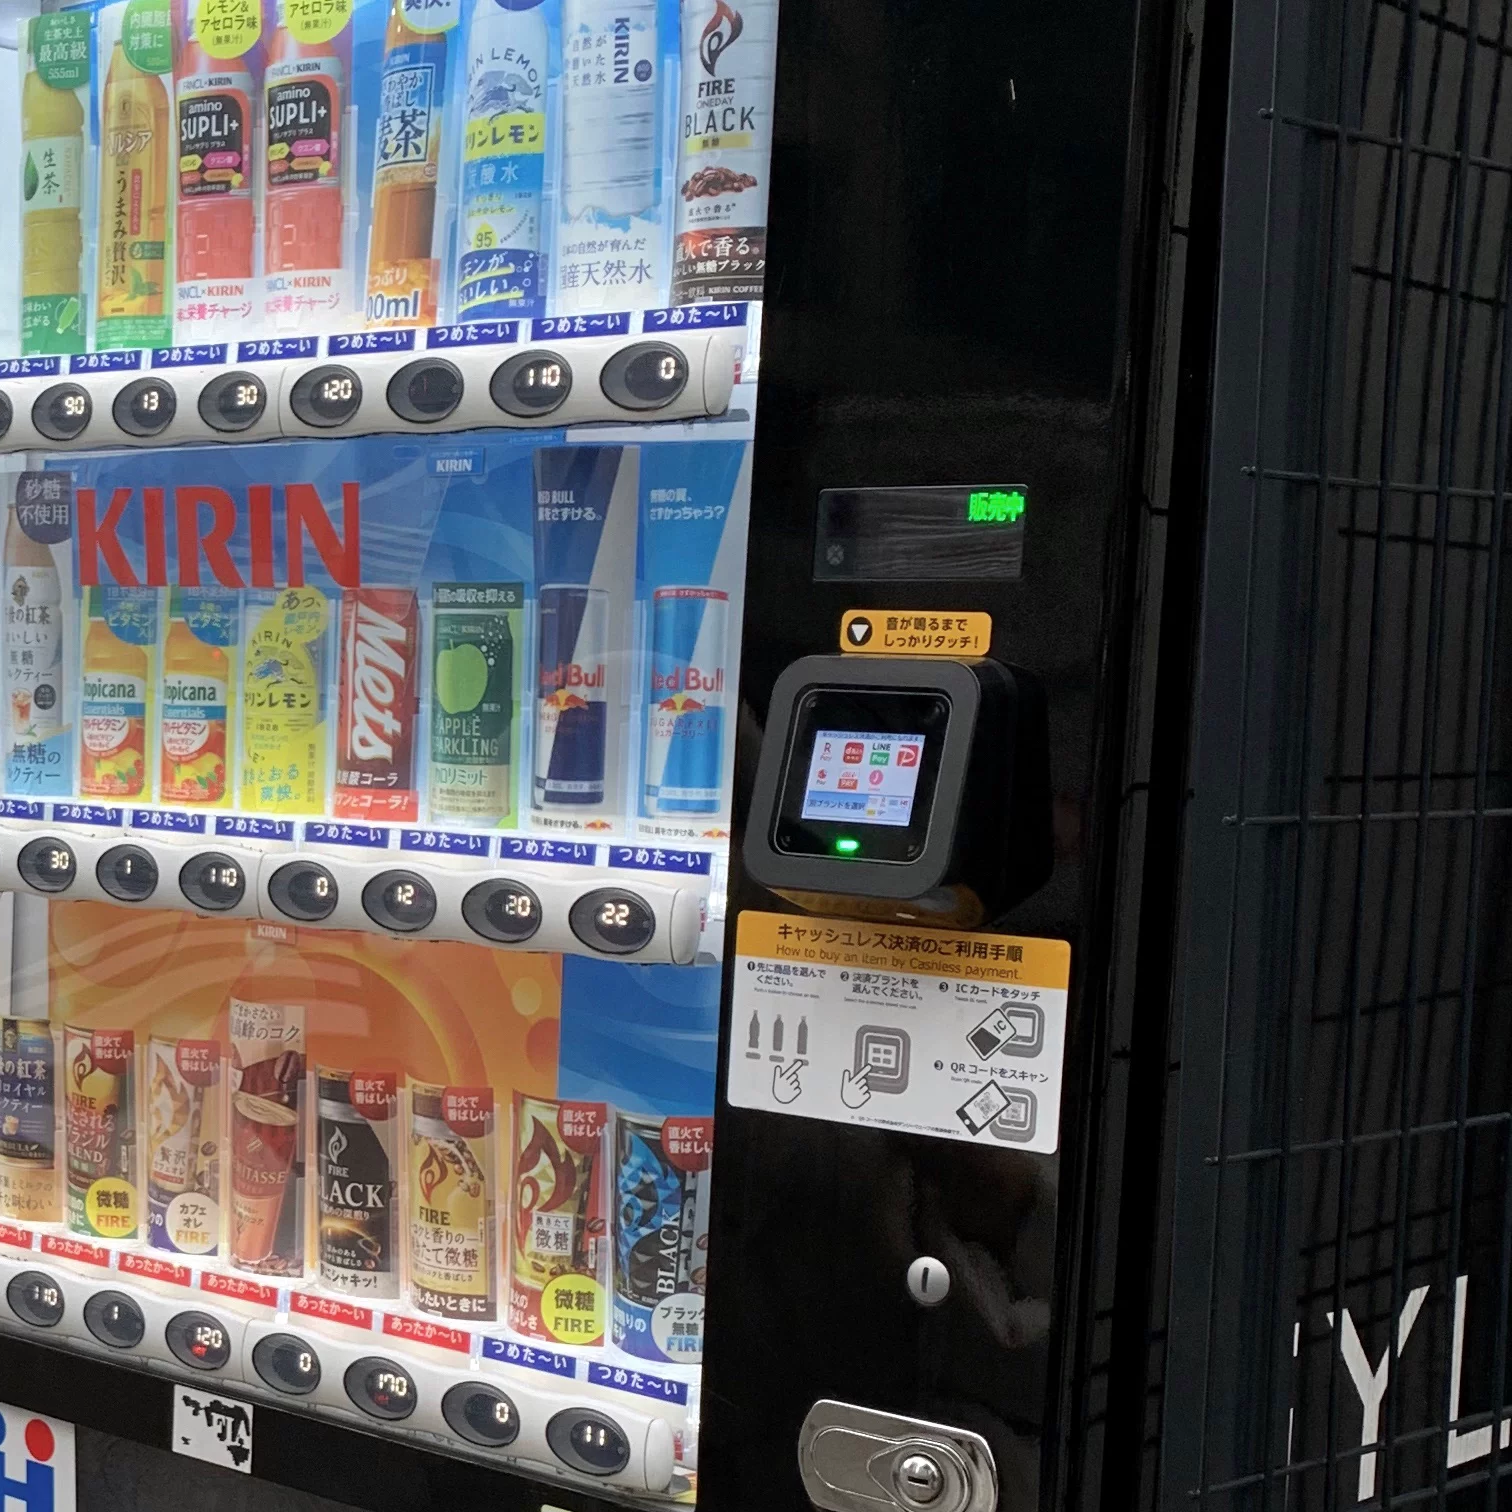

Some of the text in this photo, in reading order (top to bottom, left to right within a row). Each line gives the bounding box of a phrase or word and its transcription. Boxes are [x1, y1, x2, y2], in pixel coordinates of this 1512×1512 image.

[289, 0, 348, 18] アセロラ味
[201, 15, 258, 33] アセロラ味
[39, 43, 87, 63] 最高級
[614, 17, 630, 84] KIRIN
[491, 48, 543, 99] LEMON
[277, 86, 311, 101] amino
[698, 78, 735, 98] FIRE
[188, 100, 223, 114] amino
[696, 96, 734, 110] ONEDAY
[269, 100, 328, 129] SUPLI+
[685, 106, 756, 139] BLACK
[181, 114, 239, 141] SUPLI+
[42, 148, 60, 195] 生茶
[476, 231, 493, 249] 95
[237, 385, 257, 405] 30
[323, 379, 352, 399] 120
[65, 397, 84, 415] 90
[436, 459, 473, 472] KIRIN
[25, 478, 62, 500] 砂糖
[551, 490, 576, 504] BULL
[19, 503, 69, 526] 不使用
[969, 492, 1025, 522] 販売中
[75, 482, 361, 588] KIRIN
[886, 616, 968, 632] 音が鳴るまで
[883, 634, 979, 650] しっかりタッチ!
[351, 600, 407, 765] Mets
[566, 664, 605, 688] Bull
[684, 667, 724, 693] Bull
[438, 717, 481, 736] APPLE
[12, 743, 61, 765] 無糖の
[872, 743, 891, 751] LINE
[871, 754, 888, 763] Pay
[50, 850, 69, 869] 30
[397, 885, 414, 905] 12
[601, 903, 629, 925] 22
[256, 924, 288, 940] KIRIN
[778, 923, 1024, 965] キャッシュレス決済のご利用手順
[757, 962, 826, 979] 先に商品を選んで
[776, 944, 1023, 981] How to buy an item by Cashless payment.
[757, 975, 794, 988] ください。
[853, 972, 919, 989] 決済ブランドを
[852, 983, 923, 1001] 選んでください。
[993, 1019, 1008, 1035] IC
[563, 1109, 597, 1123] 直火で
[668, 1126, 705, 1140] 直火で
[328, 1165, 350, 1178] FIRE
[96, 1190, 131, 1210] 微糖
[320, 1175, 385, 1208] LACK
[179, 1203, 207, 1216] カフェ
[419, 1206, 451, 1226] FIRE
[96, 1214, 131, 1228] FIRE
[183, 1217, 203, 1228] オレ
[175, 1230, 212, 1246] FIRE
[535, 1229, 569, 1251] 微糖
[656, 1209, 681, 1295] BLACK
[553, 1287, 595, 1312] 微糖
[553, 1316, 595, 1335] FIRE
[671, 1322, 699, 1337] 無糖
[196, 1326, 223, 1347] 120
[1285, 1272, 1511, 1503] YL
